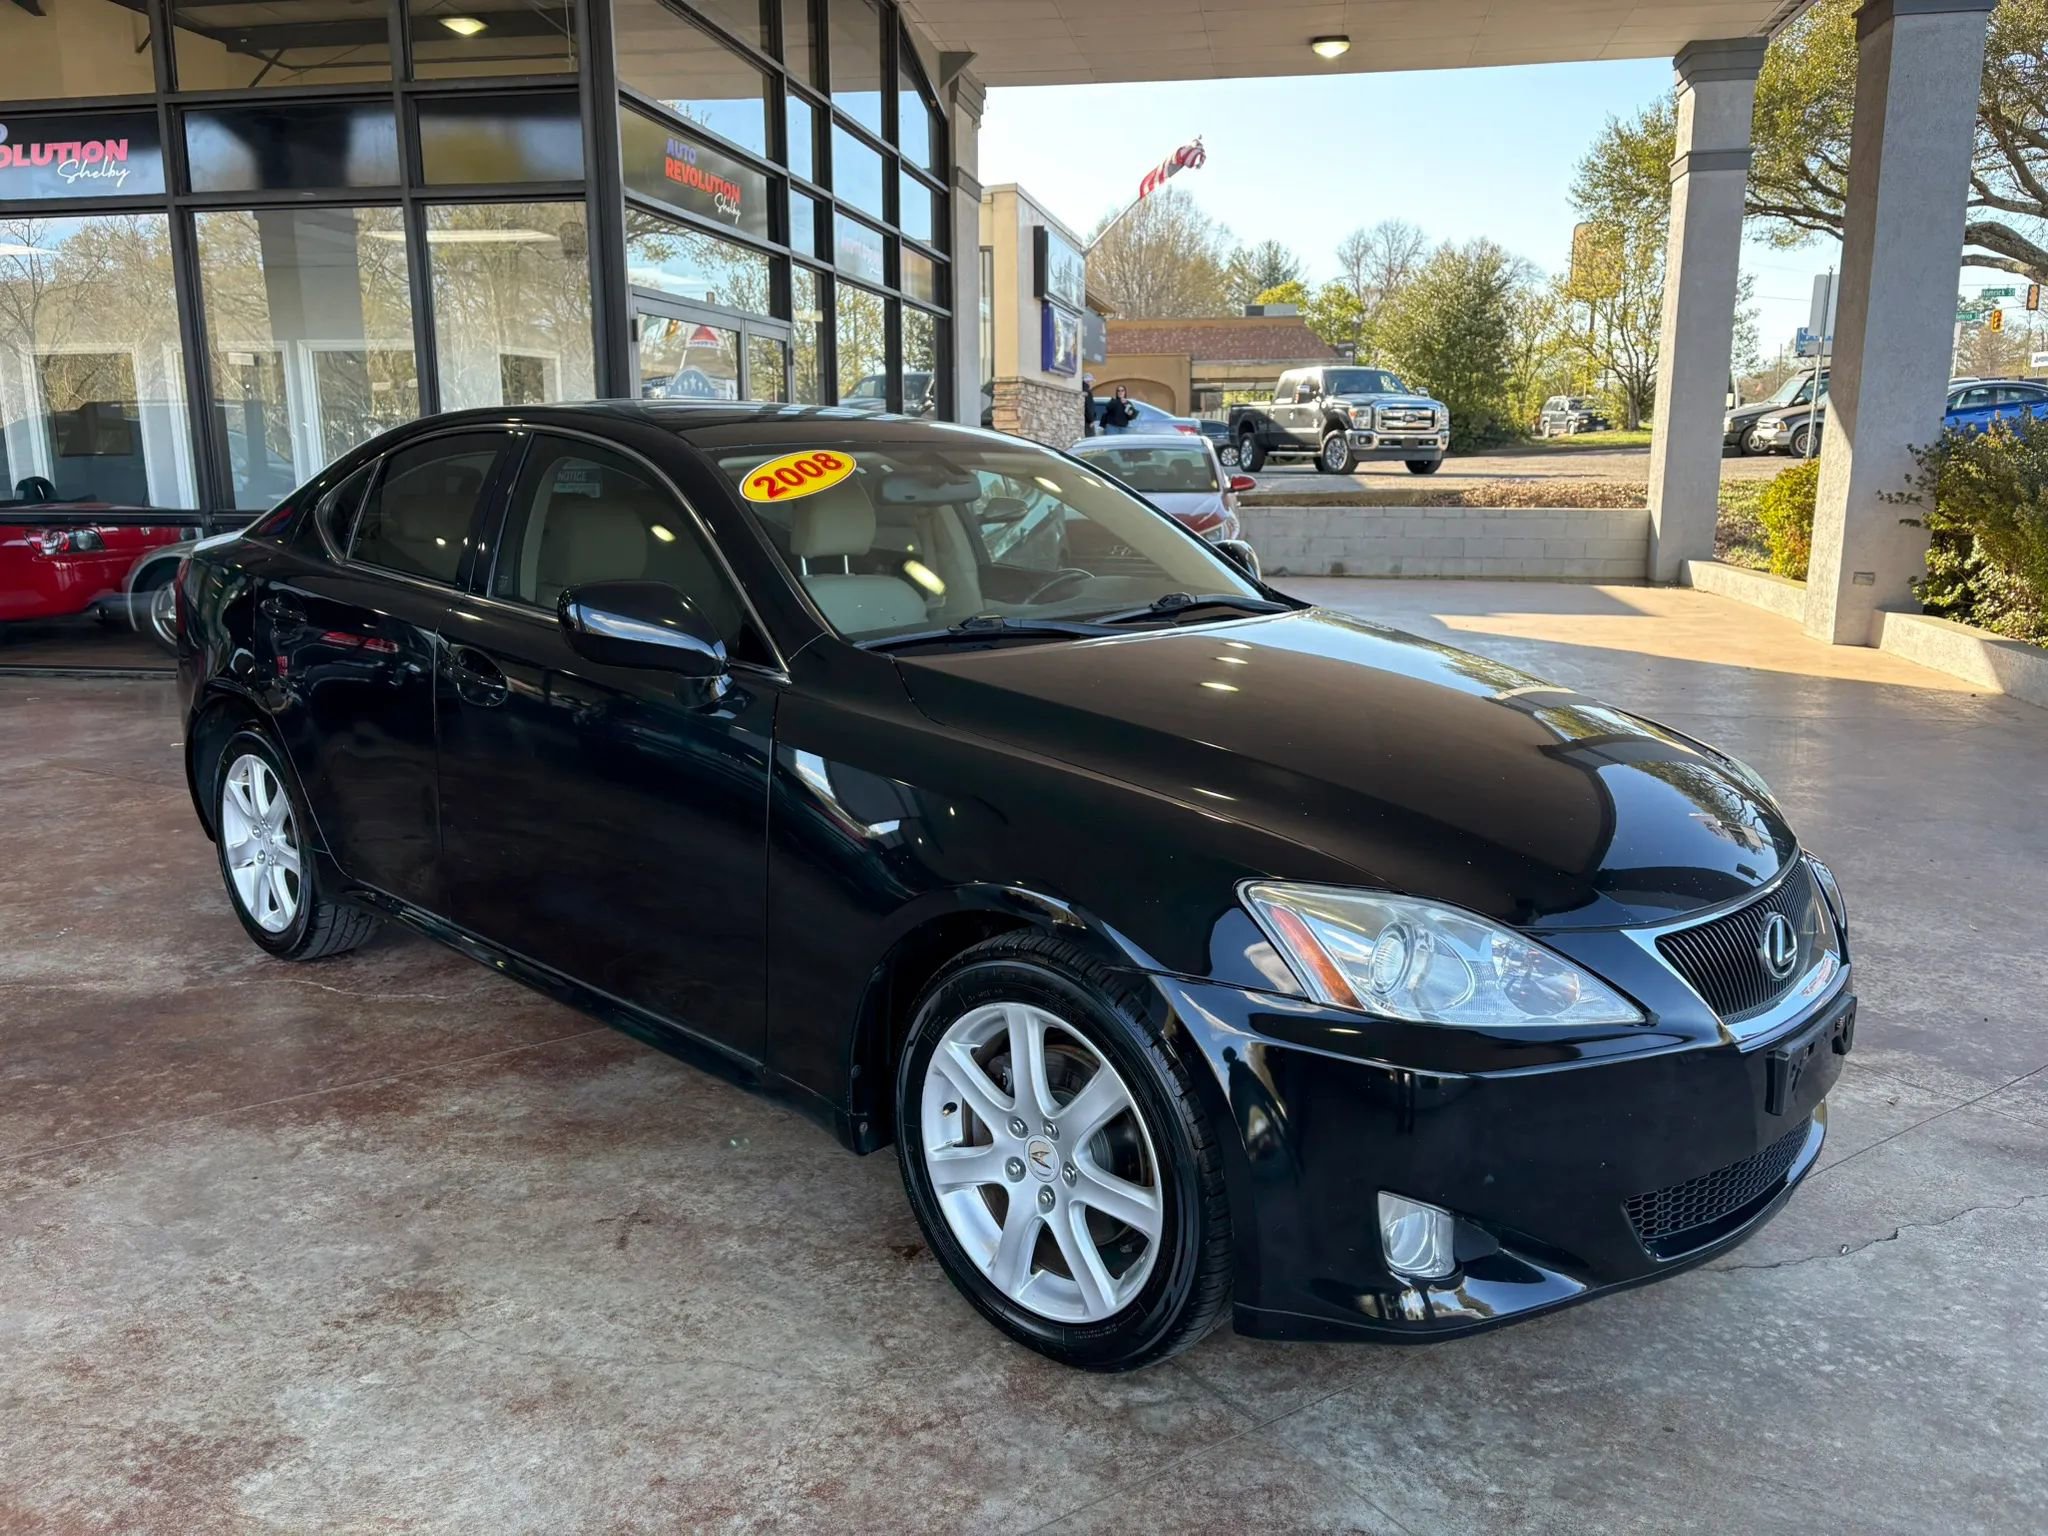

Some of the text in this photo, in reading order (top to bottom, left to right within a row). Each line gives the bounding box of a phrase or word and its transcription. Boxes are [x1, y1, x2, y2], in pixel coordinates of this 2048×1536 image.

[667, 138, 697, 165] AUTO
[57, 156, 131, 188] Shelby
[665, 156, 742, 204] REVOLUTION
[714, 192, 742, 224] Shelby
[753, 453, 844, 499] 2008
